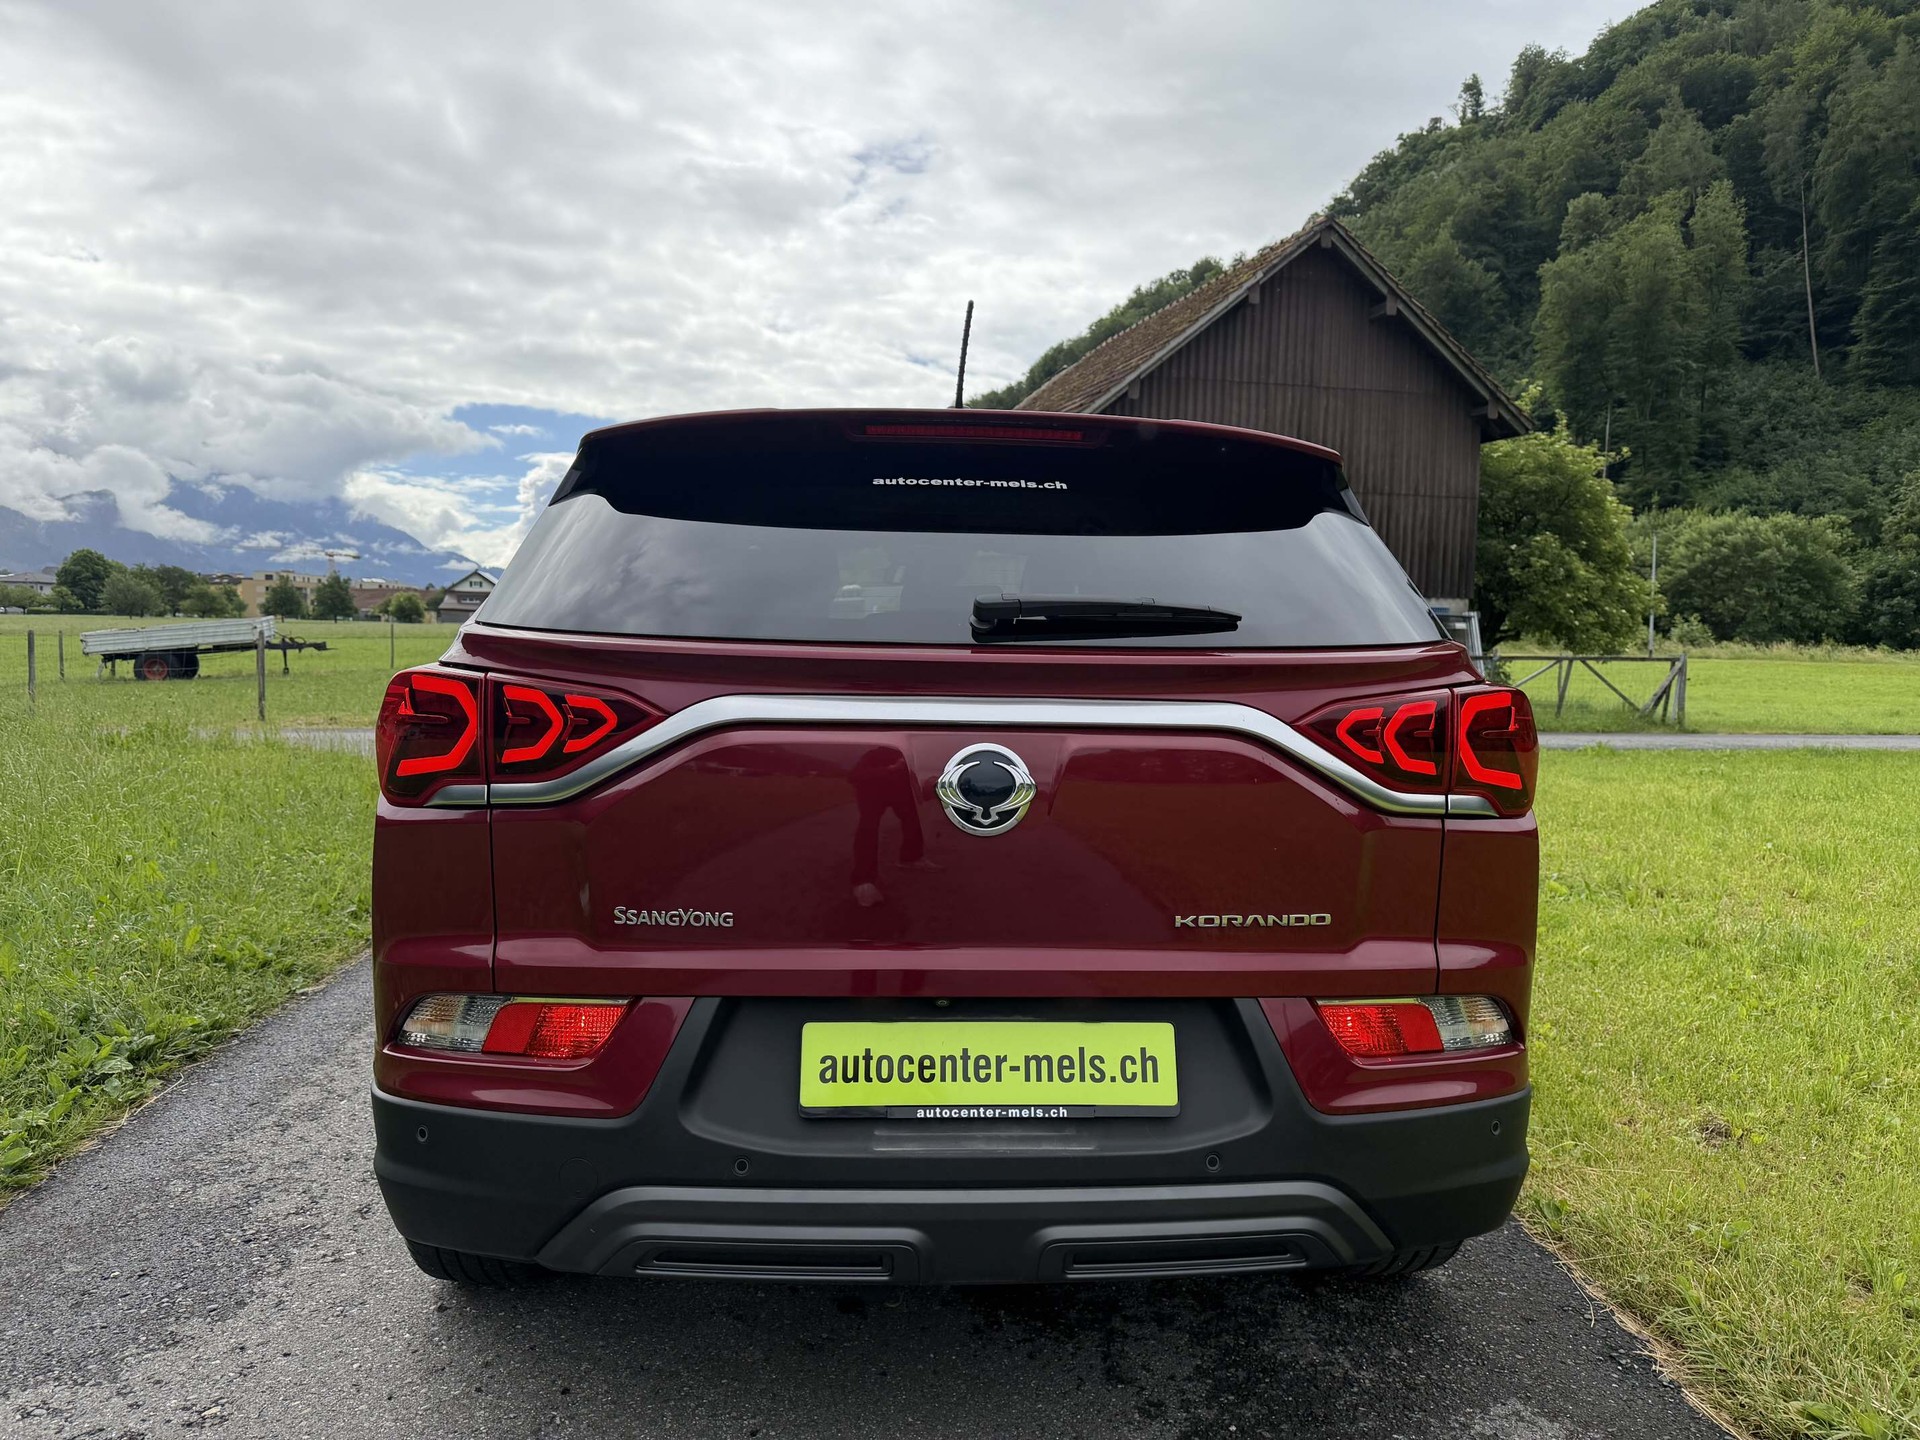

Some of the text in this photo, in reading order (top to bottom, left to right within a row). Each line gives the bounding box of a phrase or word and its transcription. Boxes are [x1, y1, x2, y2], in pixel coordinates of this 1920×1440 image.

[872, 477, 1068, 490] autocenter-mels.ch
[1174, 913, 1332, 928] KORANDO
[818, 1046, 1160, 1084] autocenter-mels.ch
[915, 1105, 1068, 1119] autocenter-mels.ch
